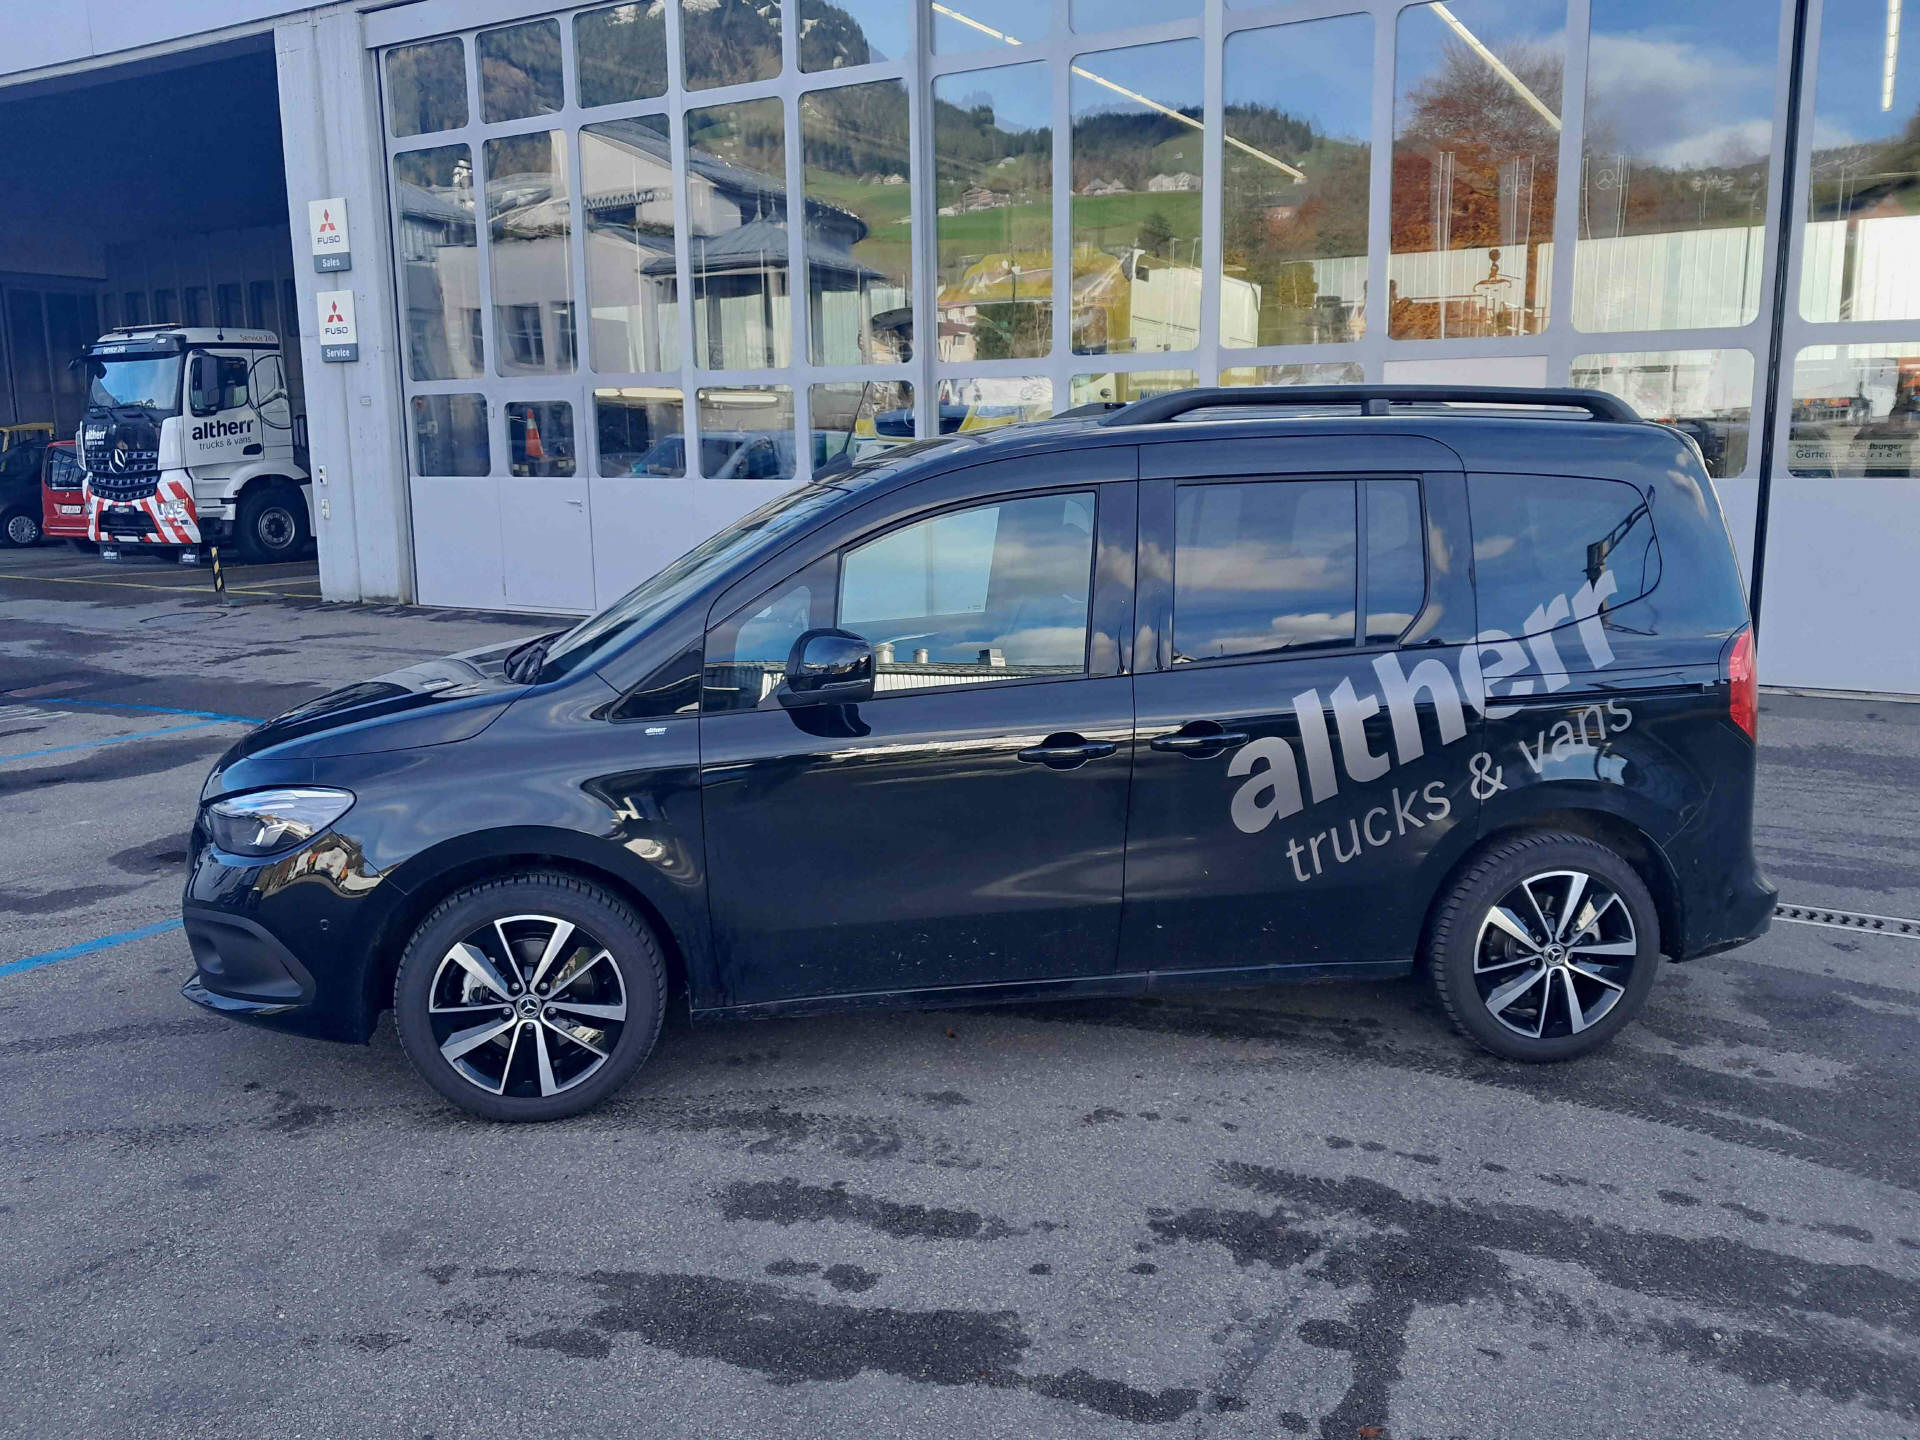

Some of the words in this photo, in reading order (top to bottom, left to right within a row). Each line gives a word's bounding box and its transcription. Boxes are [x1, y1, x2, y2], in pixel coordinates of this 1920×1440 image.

[317, 235, 341, 245] FUSO
[322, 258, 340, 268] Sales
[325, 326, 349, 335] FUSO
[326, 348, 350, 357] Service
[191, 419, 254, 440] altherr
[200, 440, 224, 450] trucks
[226, 438, 233, 446] &
[234, 436, 252, 445] vans
[1227, 570, 1618, 834] altherr
[1286, 780, 1451, 882] trucks
[1469, 752, 1508, 800] &
[1518, 698, 1633, 774] vans
